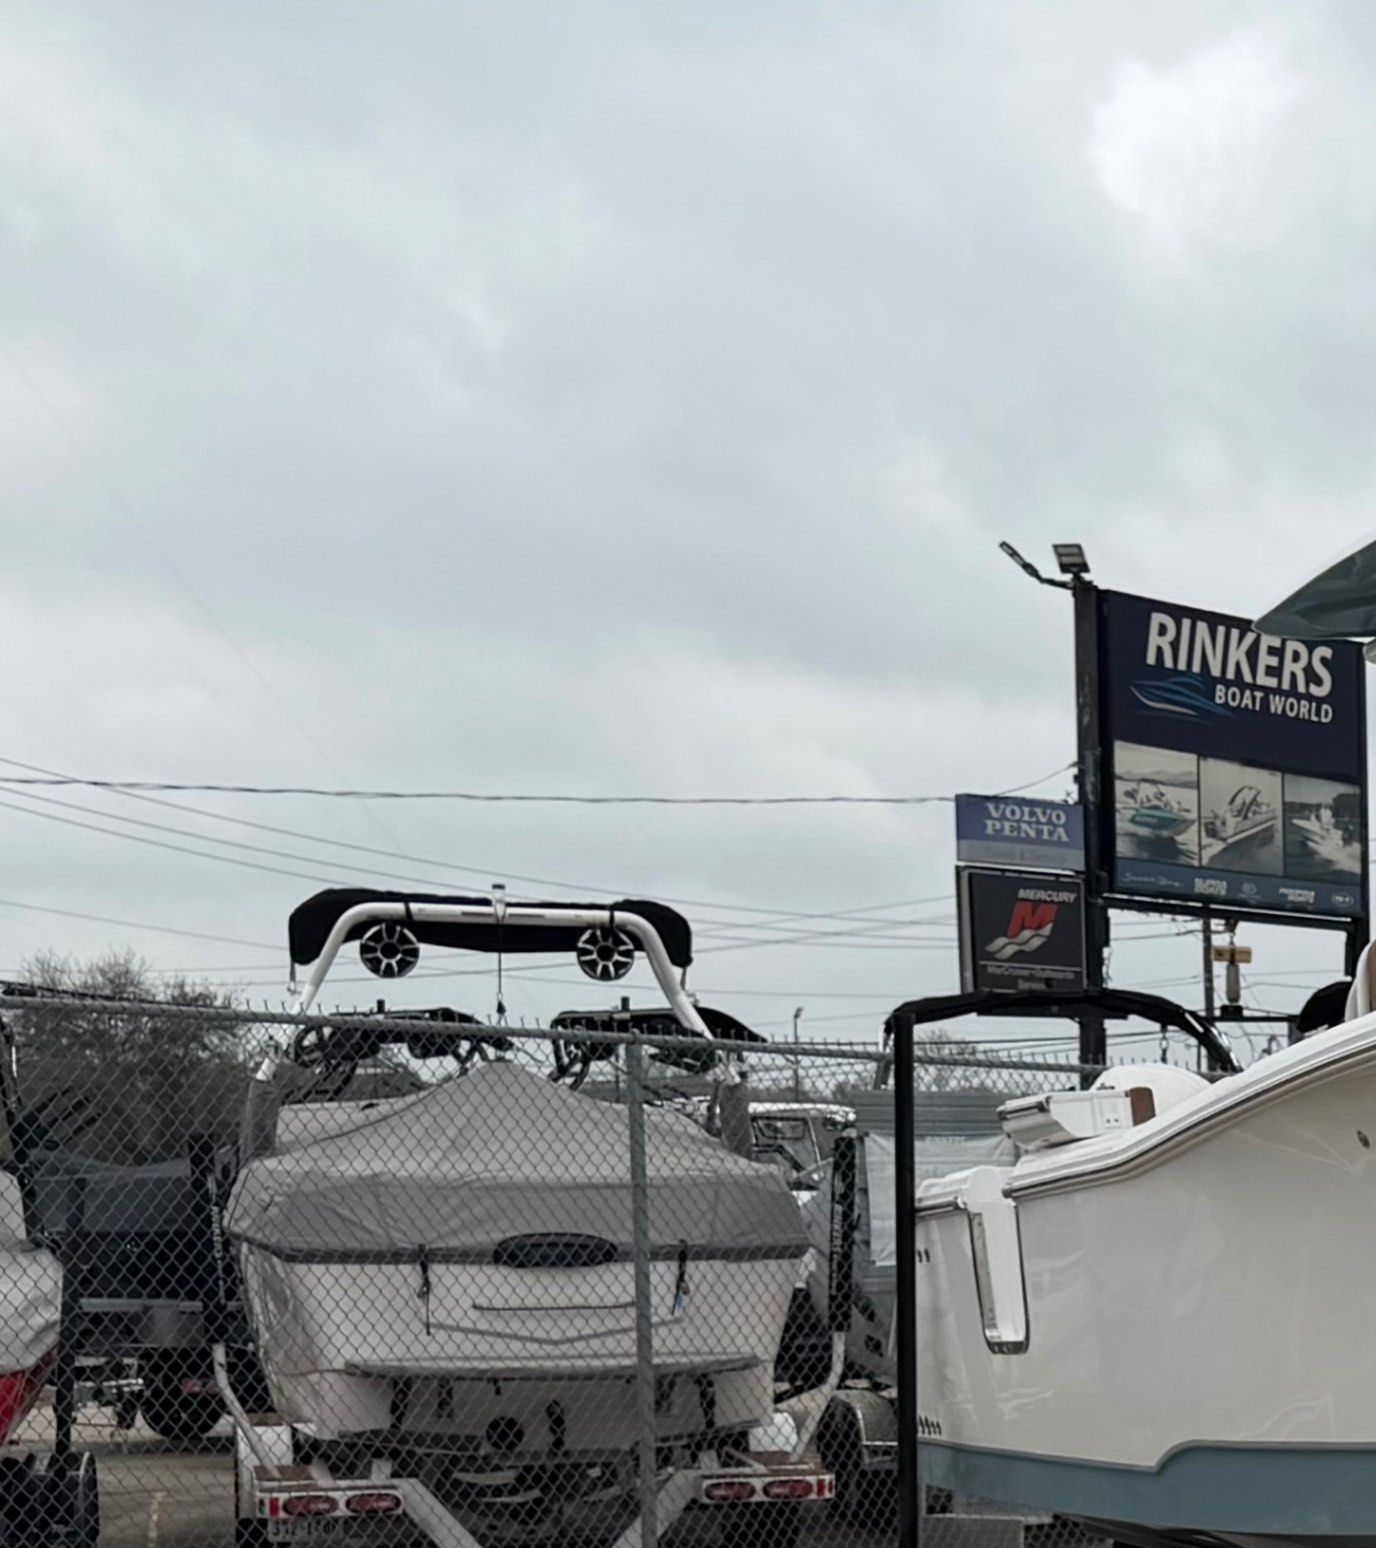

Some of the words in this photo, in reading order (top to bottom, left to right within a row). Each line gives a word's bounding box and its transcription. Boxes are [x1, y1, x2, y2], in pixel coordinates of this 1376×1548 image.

[1146, 612, 1333, 697] RINKERS
[1215, 684, 1265, 711] BOAT
[1269, 694, 1333, 723] WORLD
[986, 803, 1067, 825] VOLVO
[985, 819, 1069, 842] PENTA
[1017, 888, 1077, 903] MERCURY
